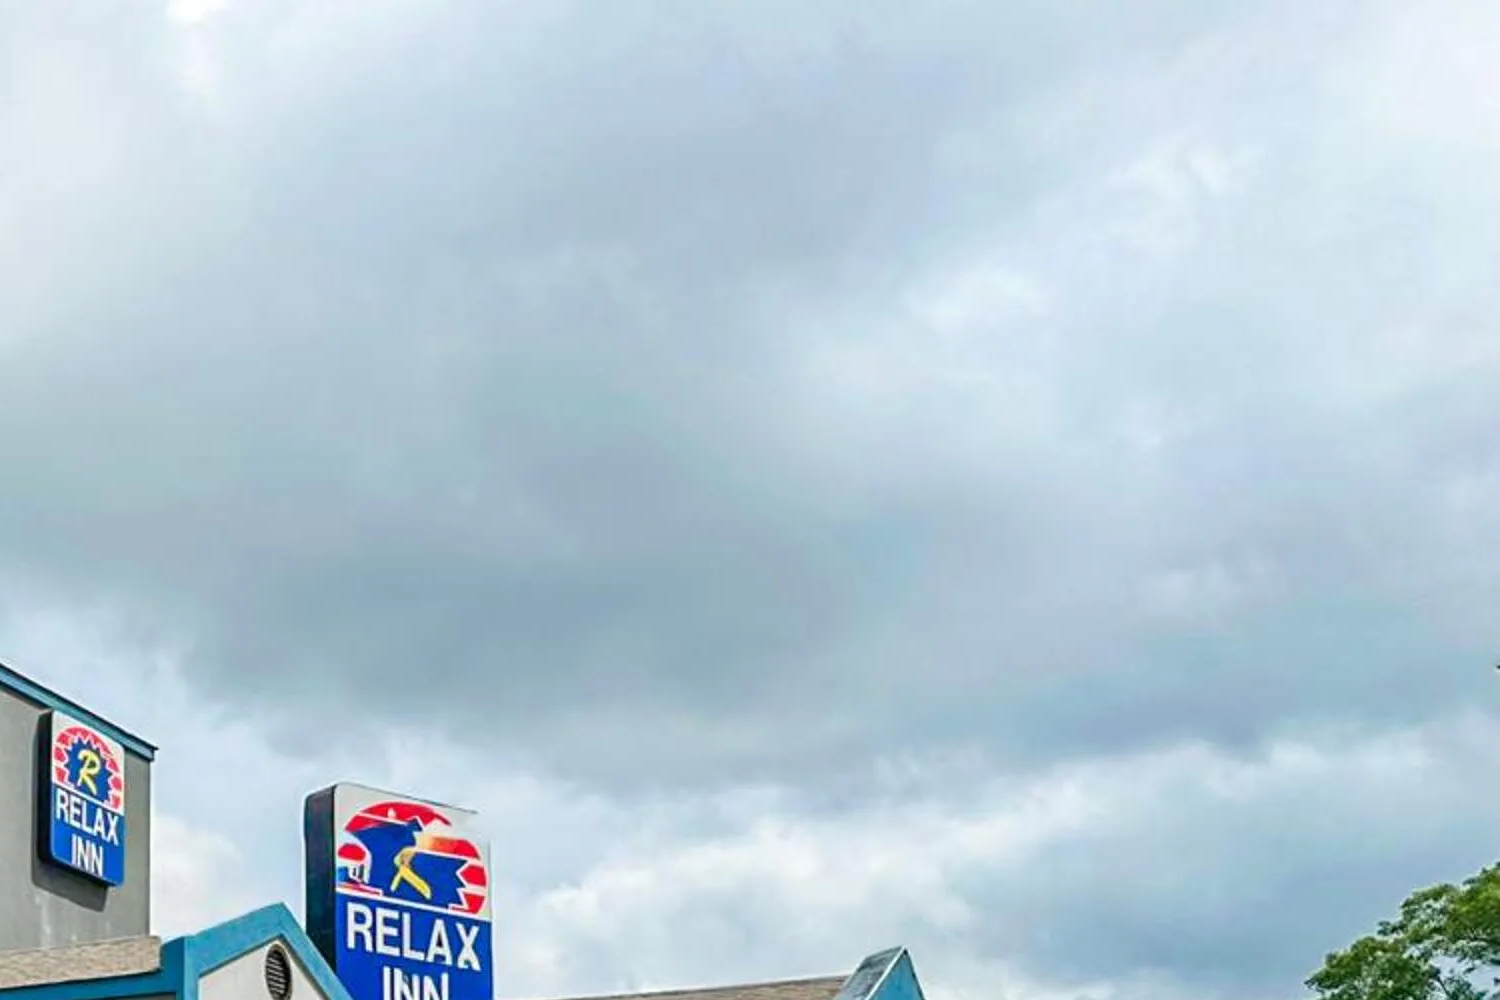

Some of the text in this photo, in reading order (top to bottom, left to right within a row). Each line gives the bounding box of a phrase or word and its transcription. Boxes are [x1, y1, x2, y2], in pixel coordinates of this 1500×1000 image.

[56, 789, 120, 846] RELAX
[71, 833, 104, 877] INN
[347, 902, 481, 971] RELAX
